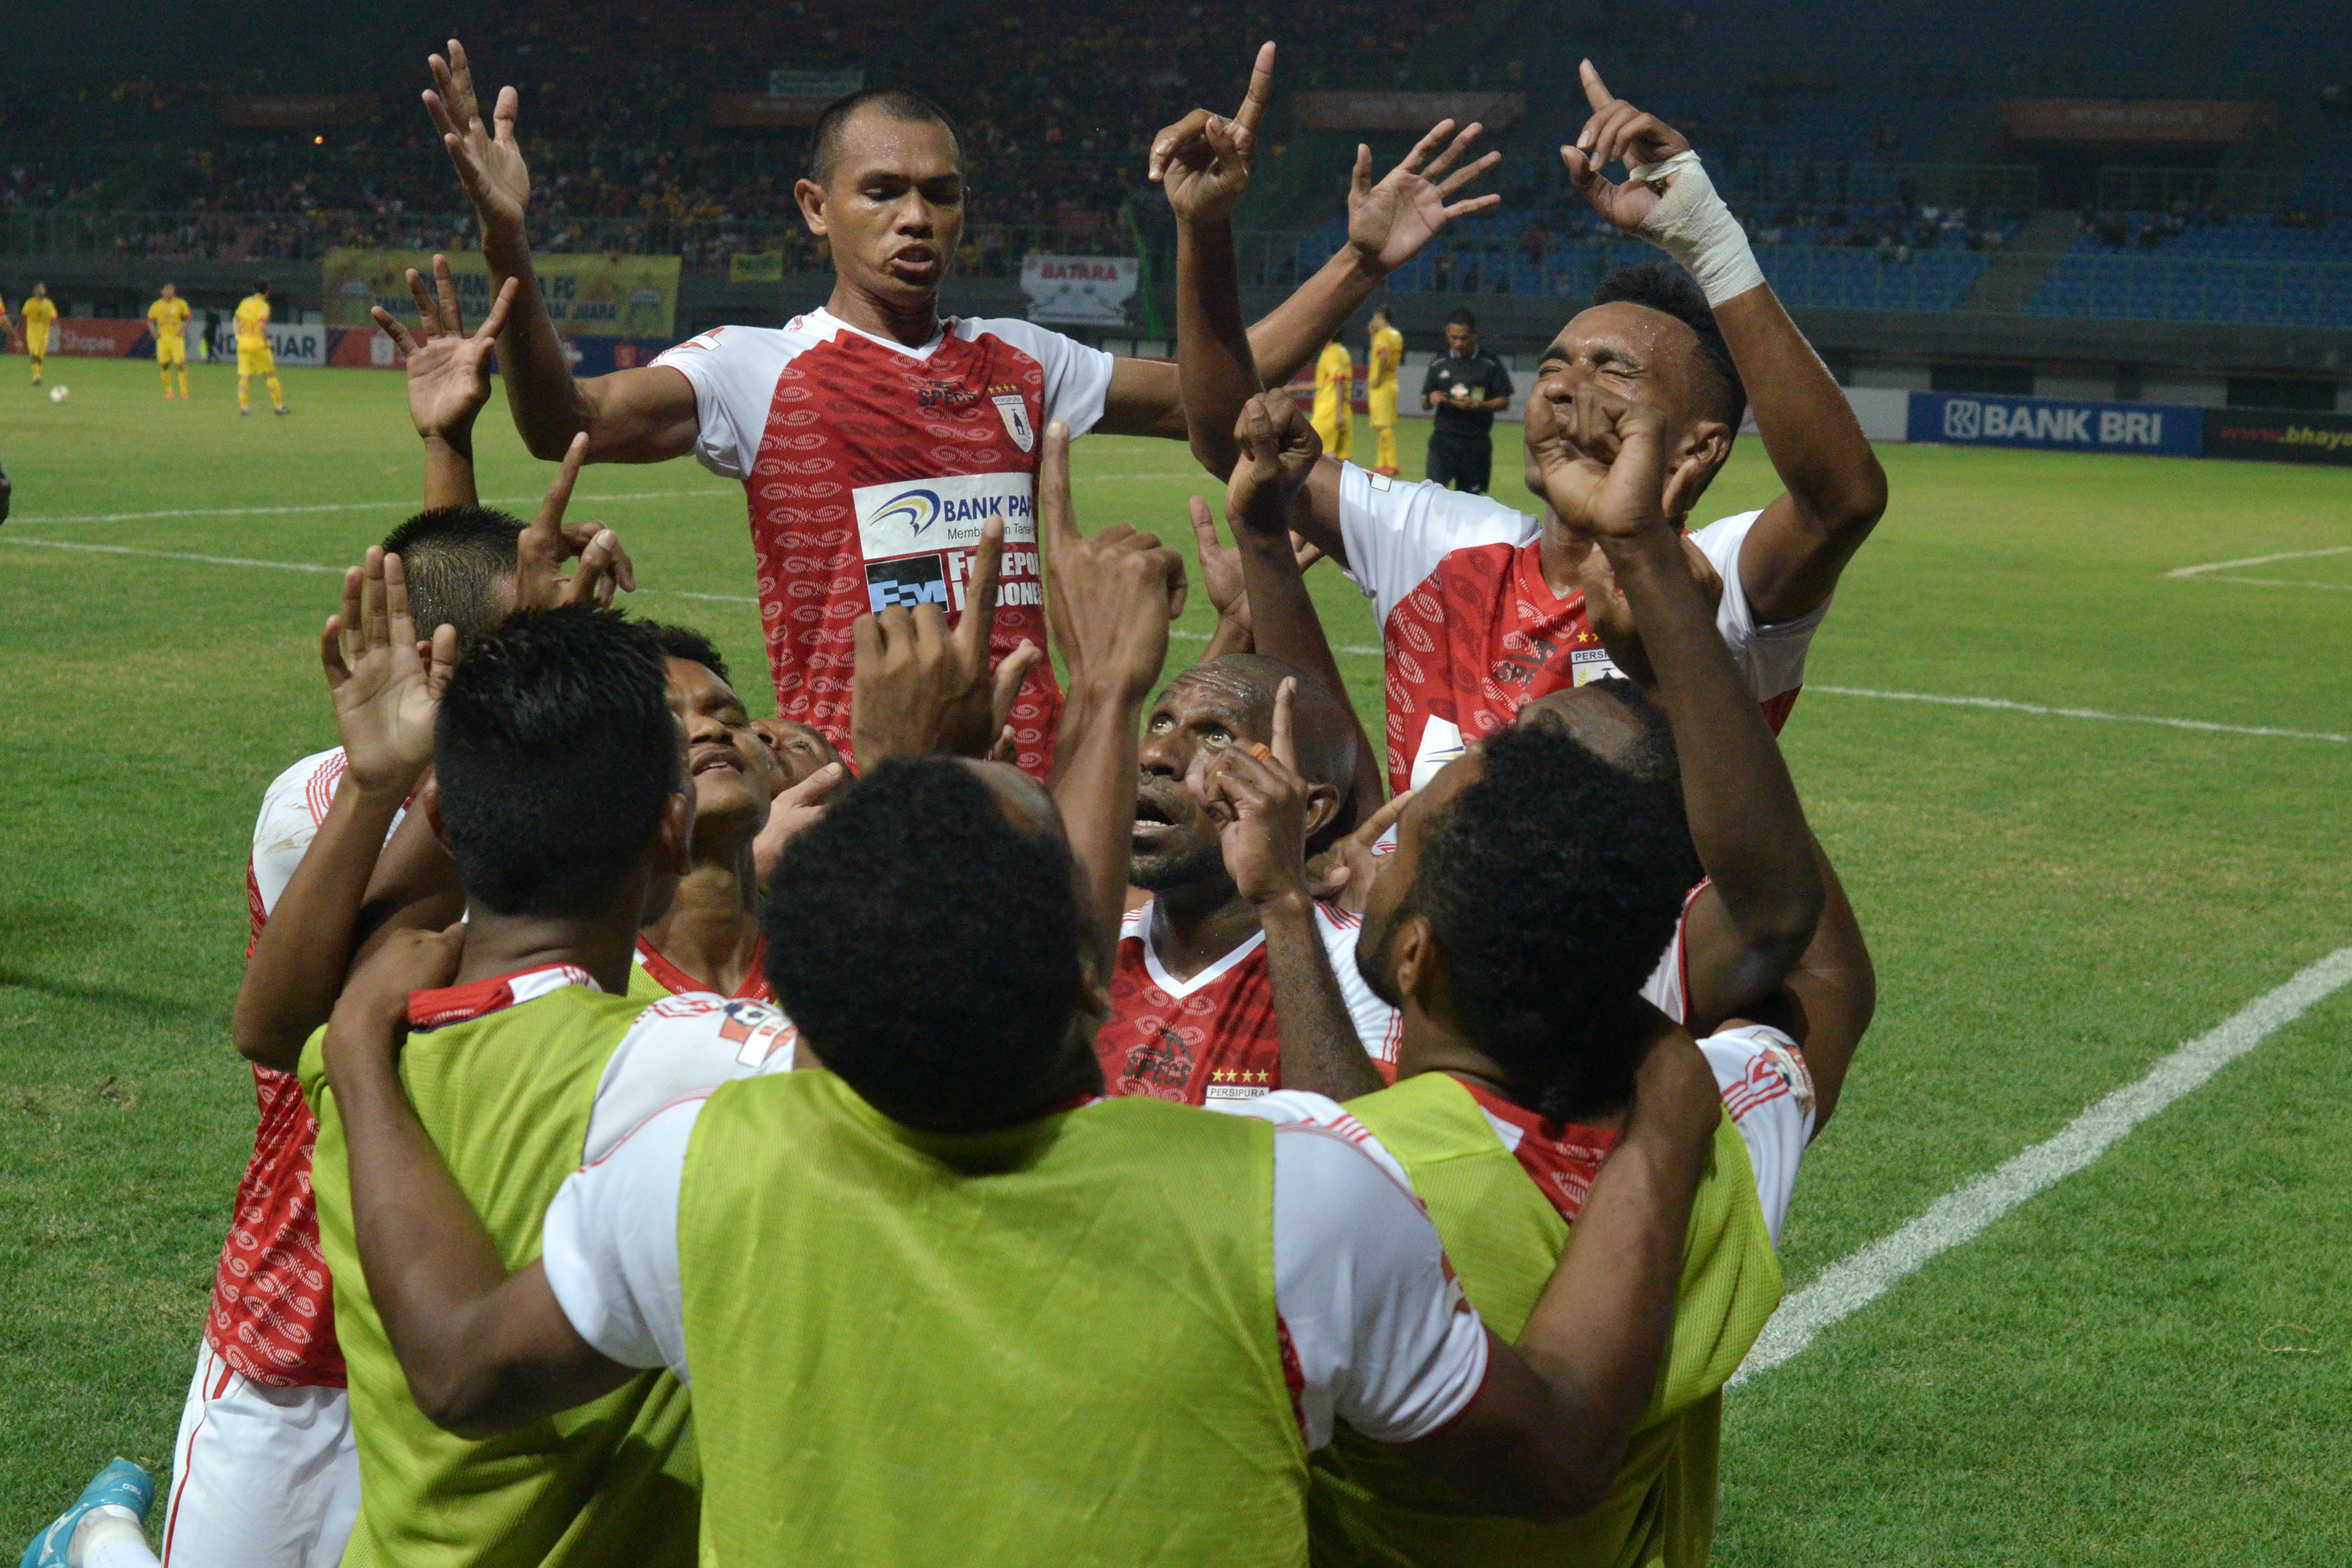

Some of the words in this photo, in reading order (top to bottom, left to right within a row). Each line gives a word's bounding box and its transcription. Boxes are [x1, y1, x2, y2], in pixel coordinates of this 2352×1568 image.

[1983, 404, 2091, 442] BANK
[2099, 412, 2161, 446] BRI
[944, 496, 1003, 522] BANK
[1122, 1055, 1192, 1086] SPECS
[1211, 1088, 1265, 1097] PERSIPURA
